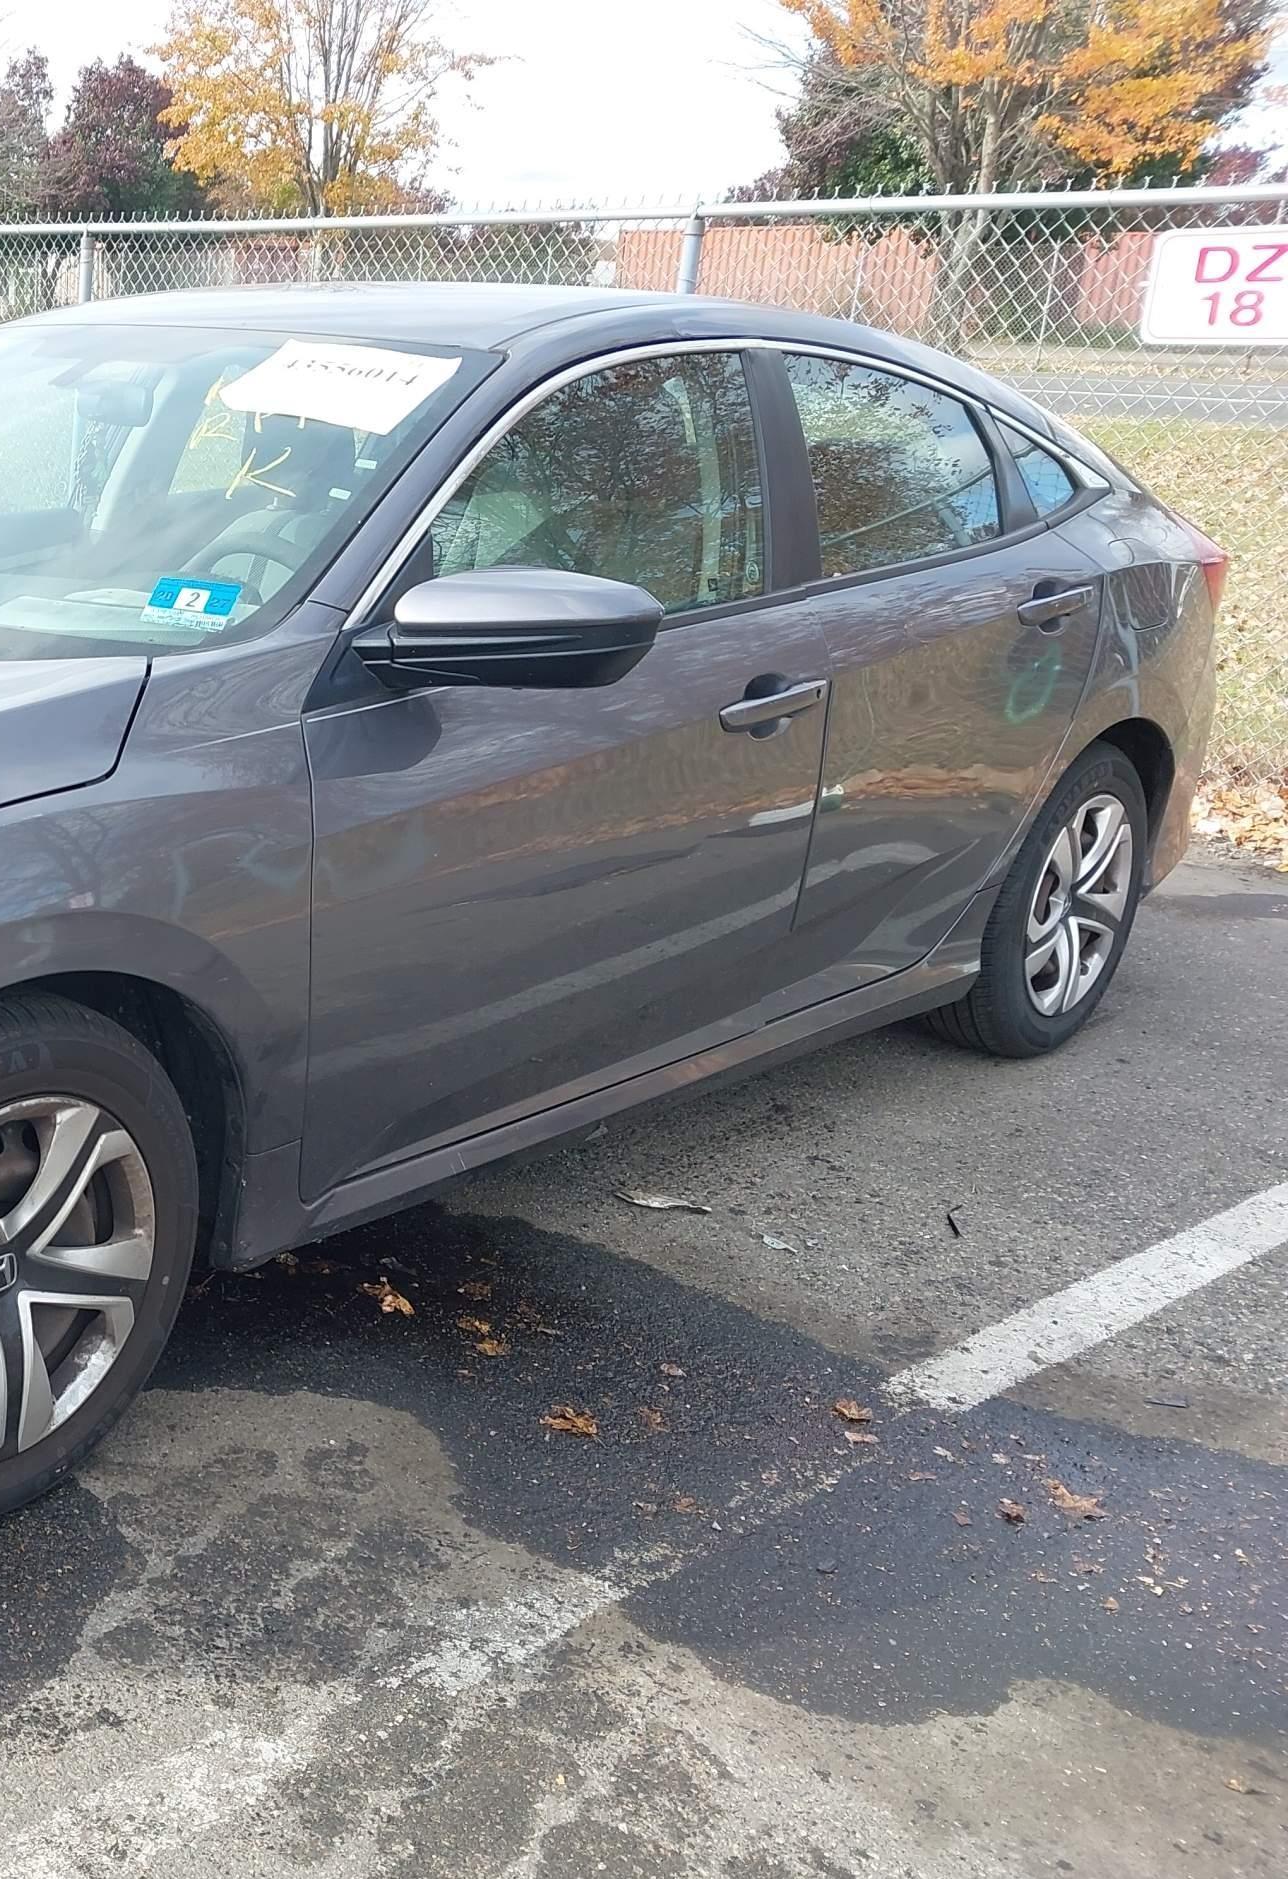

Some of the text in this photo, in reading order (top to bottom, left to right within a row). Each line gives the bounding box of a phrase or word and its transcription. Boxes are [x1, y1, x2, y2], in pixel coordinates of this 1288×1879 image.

[1194, 244, 1288, 283] DZ
[1200, 290, 1265, 326] 18
[185, 591, 201, 608] 2
